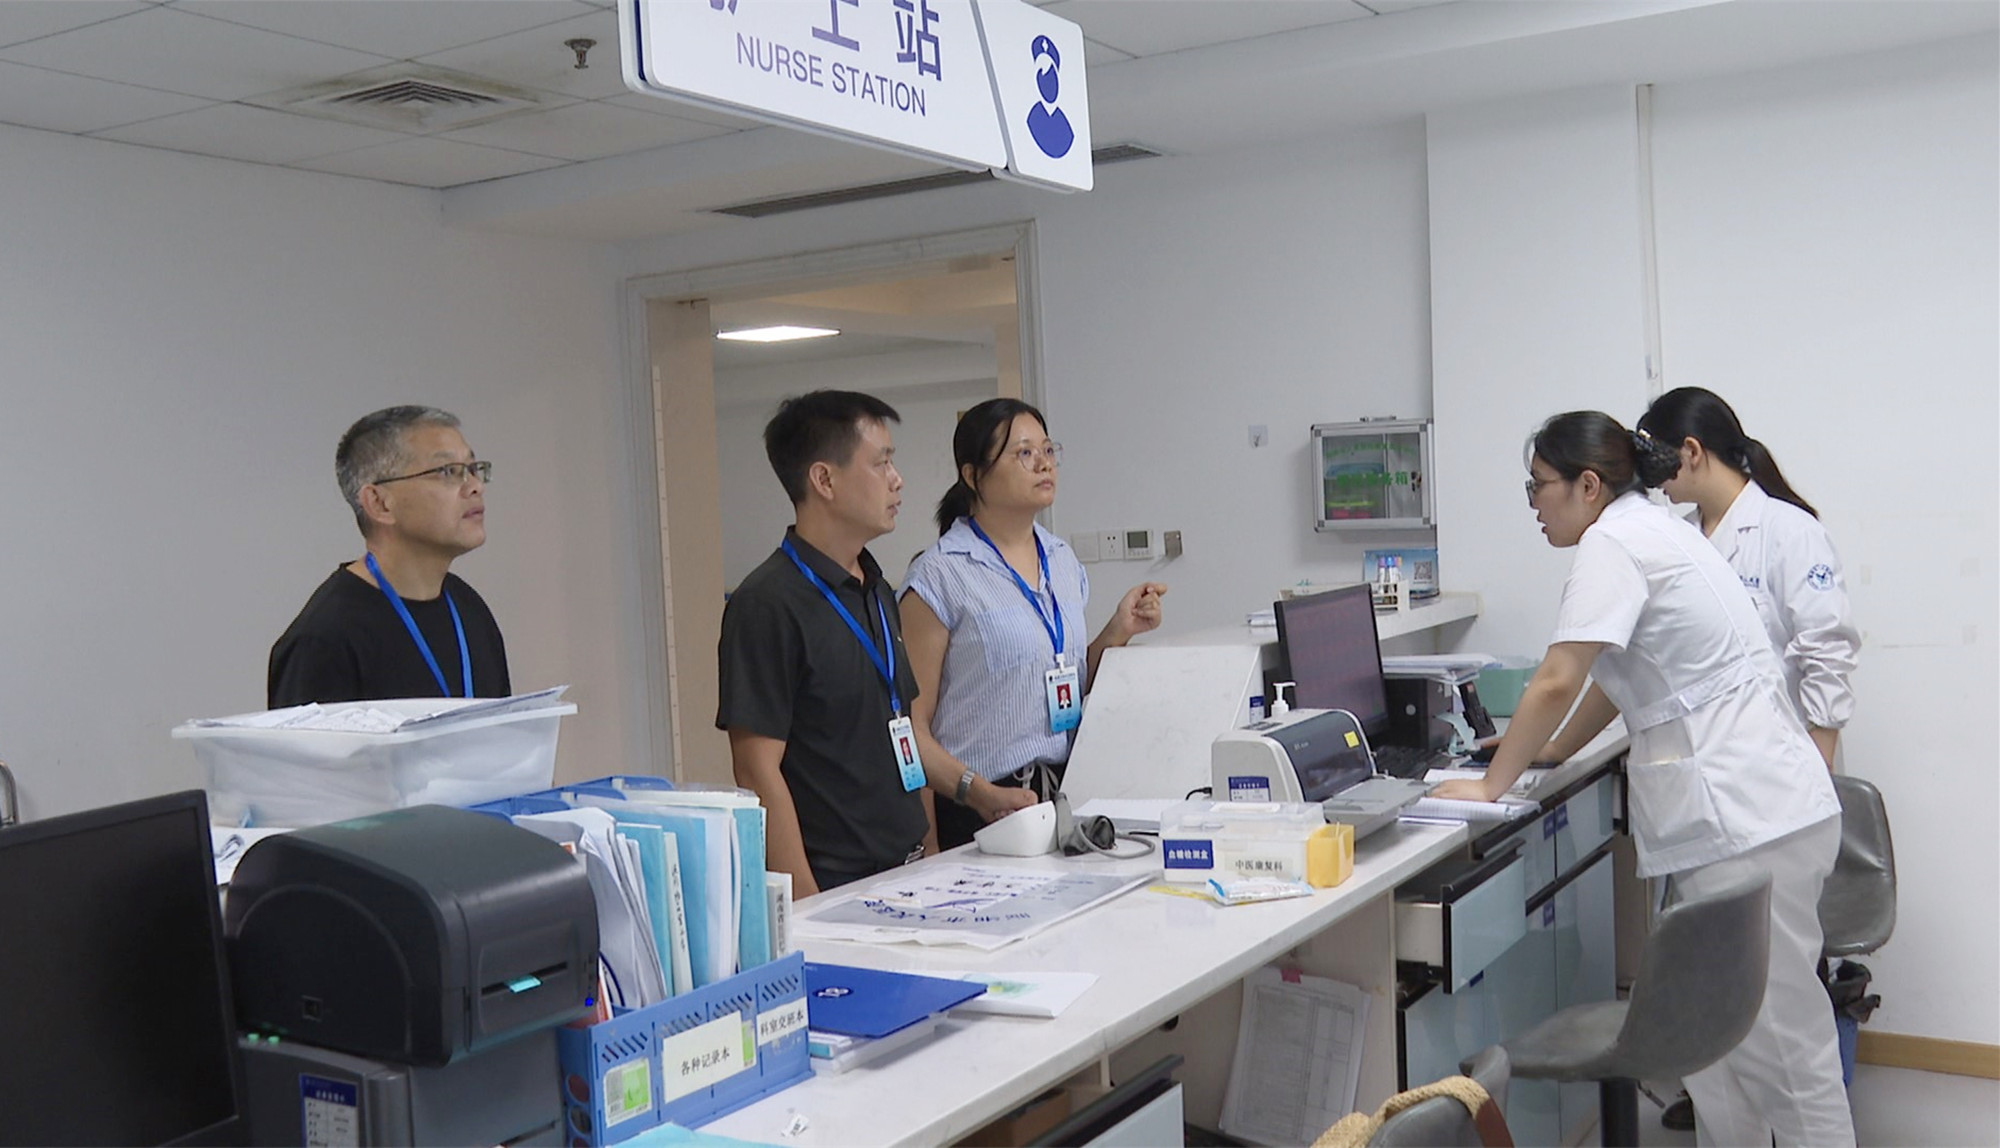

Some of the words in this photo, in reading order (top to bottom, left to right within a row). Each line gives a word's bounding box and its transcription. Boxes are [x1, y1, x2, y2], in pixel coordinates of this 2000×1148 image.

[709, 0, 942, 81] 士站
[737, 32, 823, 87] NURSE
[832, 62, 926, 117] STATION
[1235, 859, 1283, 871] 中医康复科
[760, 1008, 804, 1036] 科室交班本
[681, 1046, 731, 1077] 各种记录本
